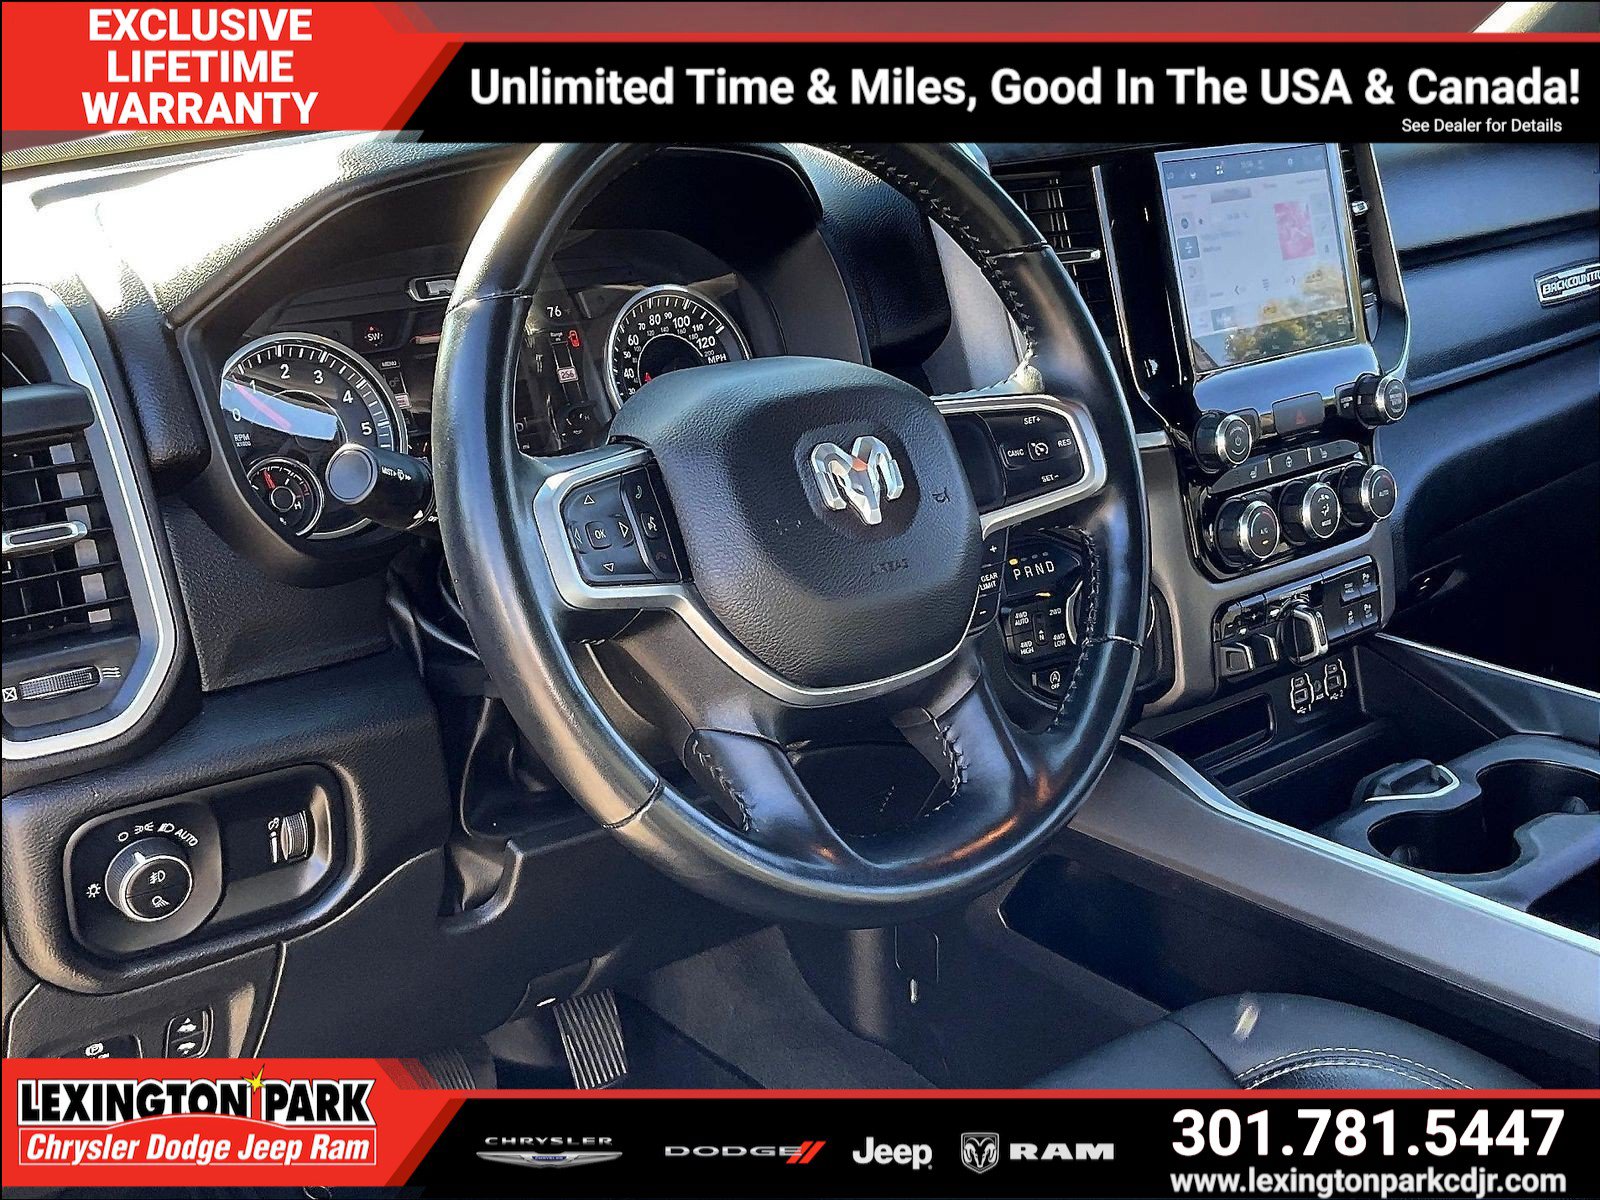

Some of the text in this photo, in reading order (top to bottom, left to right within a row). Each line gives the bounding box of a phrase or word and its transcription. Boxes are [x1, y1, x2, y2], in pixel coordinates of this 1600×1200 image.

[547, 306, 562, 318] 76
[664, 312, 672, 320] 90
[649, 314, 661, 326] 80
[673, 315, 691, 329] 100
[638, 323, 645, 331] 70
[692, 324, 704, 332] 110
[367, 333, 380, 342] SW
[628, 334, 639, 346] 60
[697, 335, 716, 350] 120
[623, 351, 631, 359] 50
[707, 354, 727, 364] MPH
[280, 364, 290, 379] 2
[314, 370, 324, 384] 3
[624, 368, 634, 379] 40
[250, 380, 257, 393] 1
[343, 390, 354, 404] 4
[232, 409, 241, 422] 0
[1024, 415, 1041, 425] SET+
[361, 422, 372, 435] 5
[234, 434, 250, 442] RPM
[1057, 438, 1072, 448] RES
[1007, 448, 1024, 457] CANC
[594, 529, 606, 539] OK
[1013, 560, 1055, 581] P R N D
[980, 572, 998, 583] GEAR
[980, 581, 997, 591] LIMIT
[174, 828, 199, 847] AUTO
